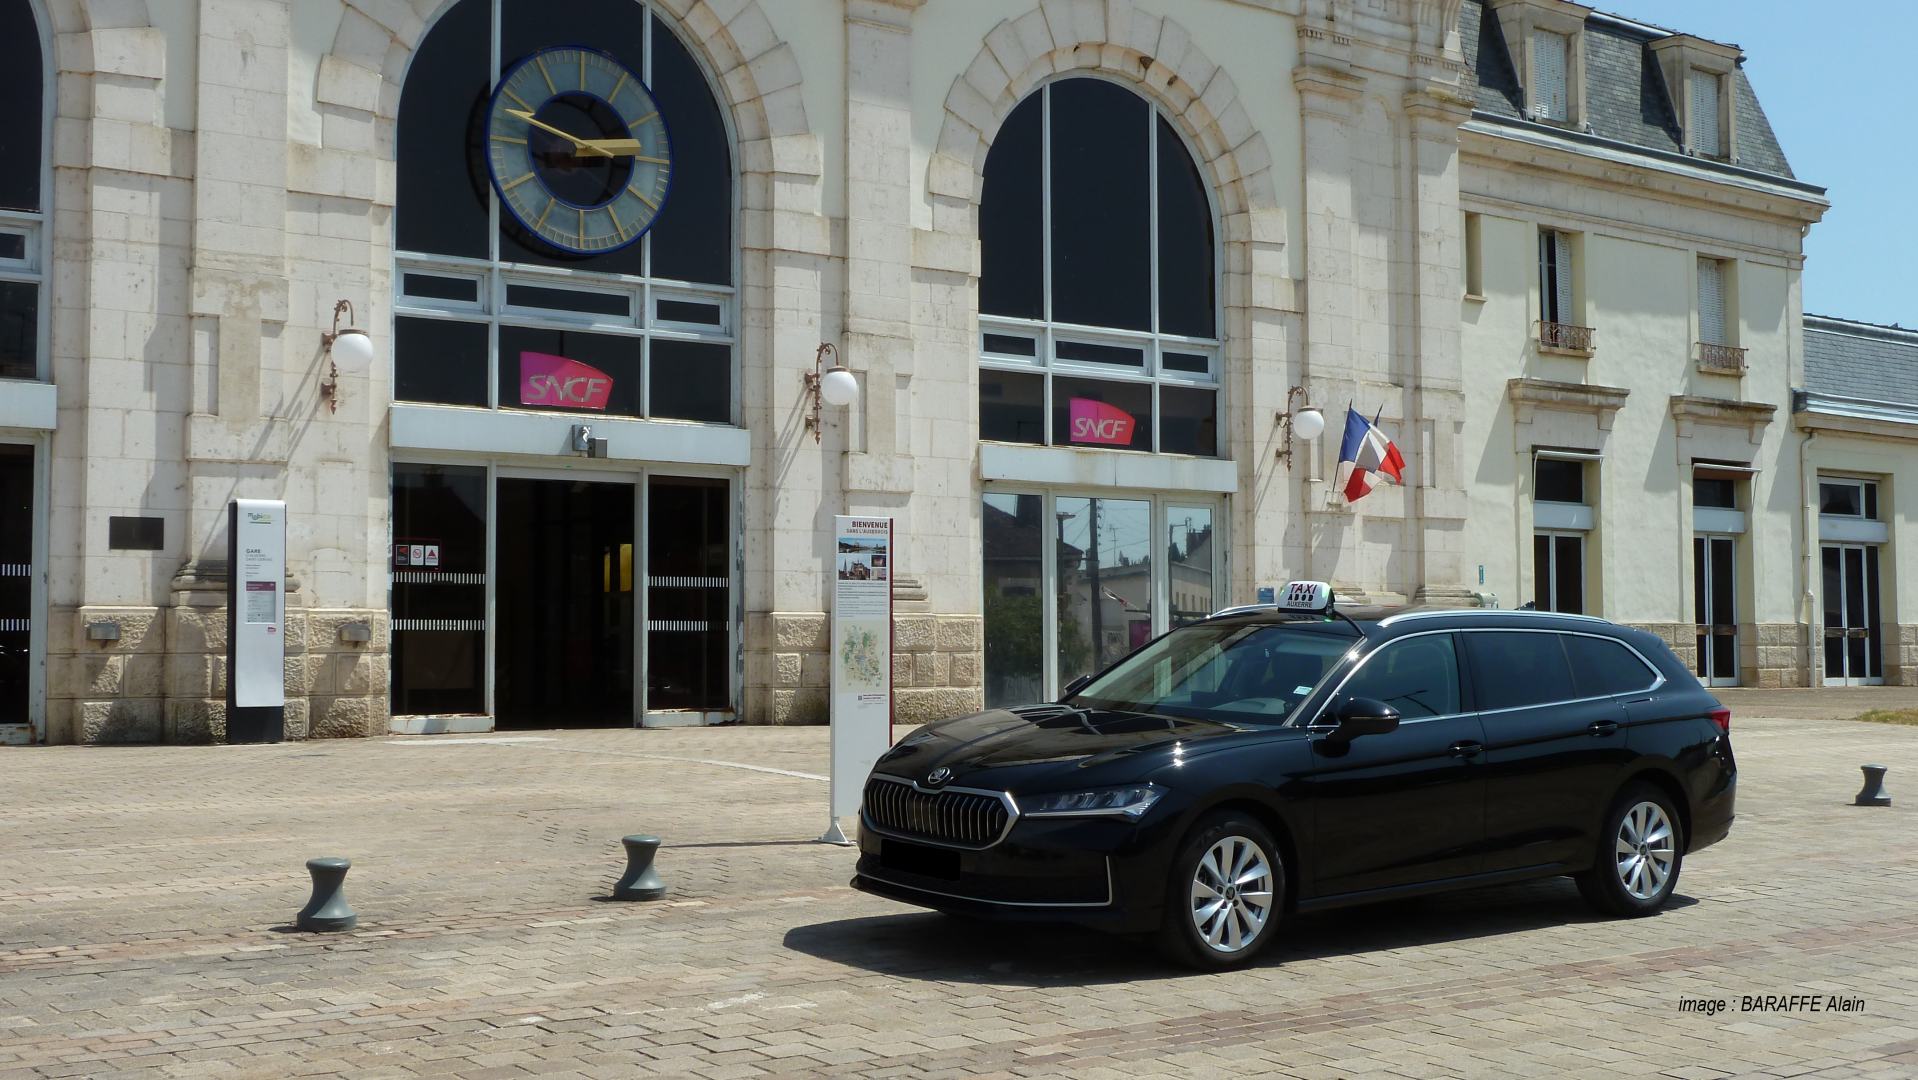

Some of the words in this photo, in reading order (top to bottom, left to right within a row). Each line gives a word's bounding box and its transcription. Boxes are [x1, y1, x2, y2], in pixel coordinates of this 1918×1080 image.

[525, 374, 607, 403] SNCF
[1072, 417, 1127, 439] SNCF
[851, 520, 889, 529] BIENVENUE
[1290, 583, 1318, 595] TAXI
